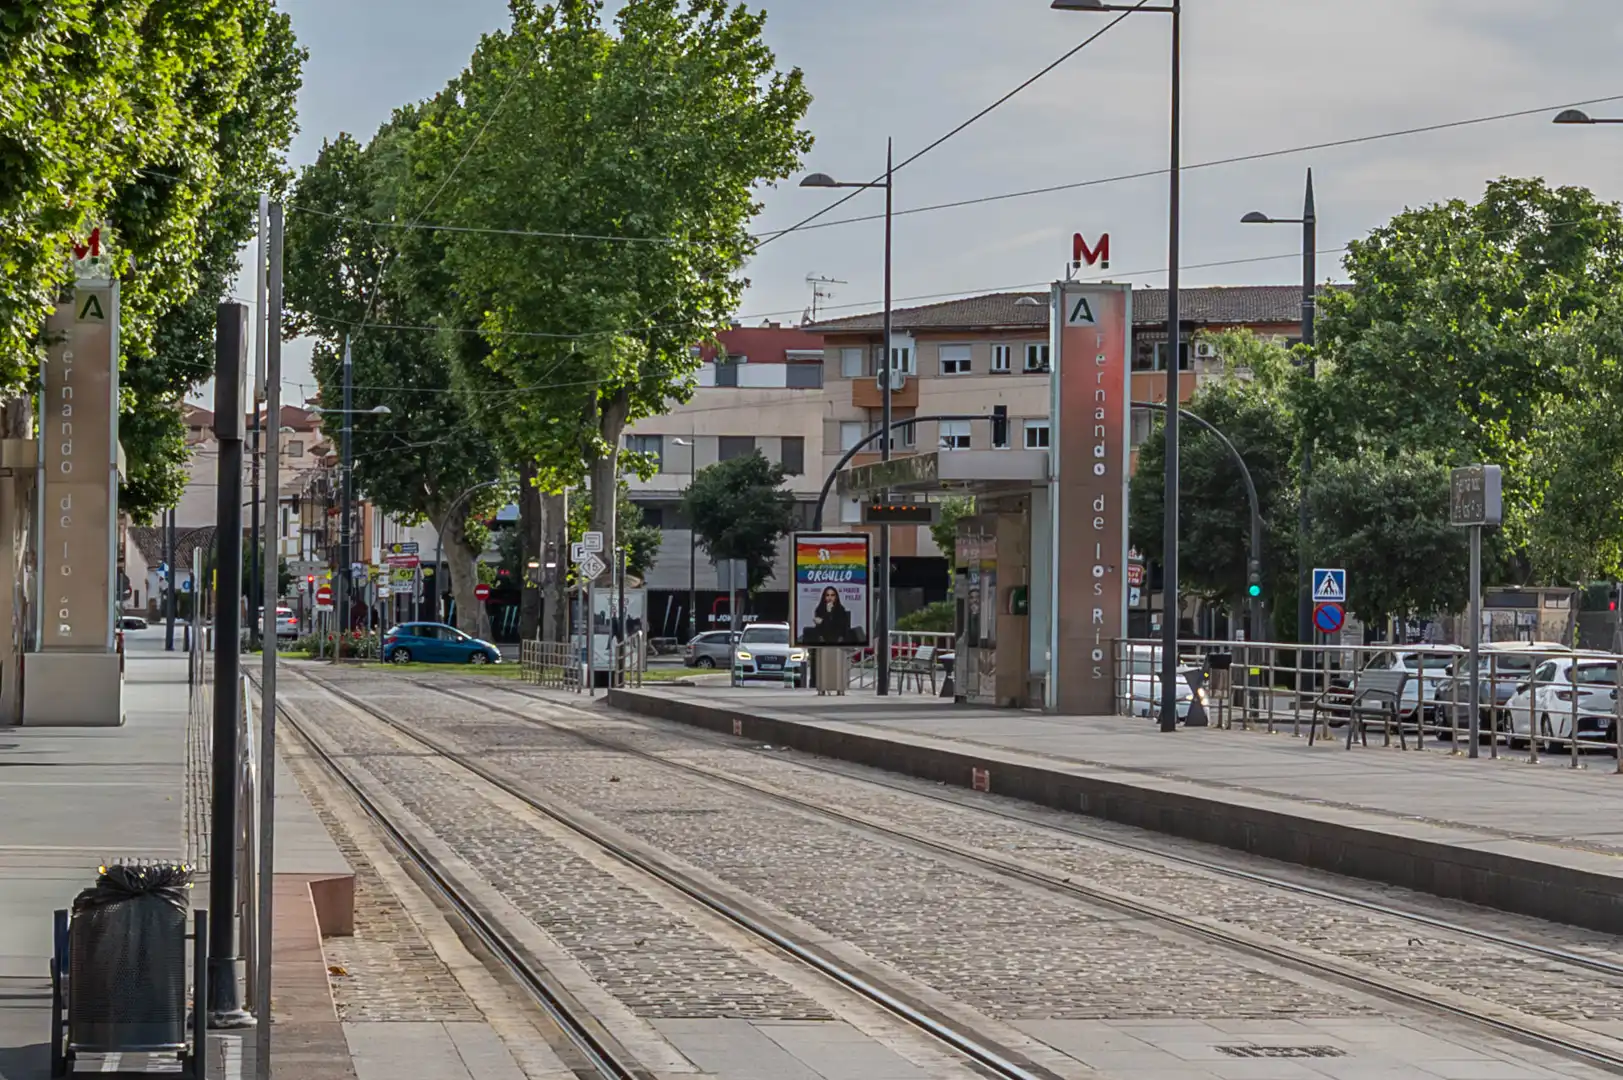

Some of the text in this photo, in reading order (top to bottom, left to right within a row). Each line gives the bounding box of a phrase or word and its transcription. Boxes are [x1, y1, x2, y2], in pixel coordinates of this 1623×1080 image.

[1072, 232, 1110, 266] M
[79, 294, 105, 319] A
[1069, 297, 1095, 323] A
[1093, 331, 1106, 476] Fernando
[60, 493, 72, 529] de
[1093, 494, 1105, 530] de
[807, 570, 853, 582] ORGULLO
[1092, 542, 1105, 596] los
